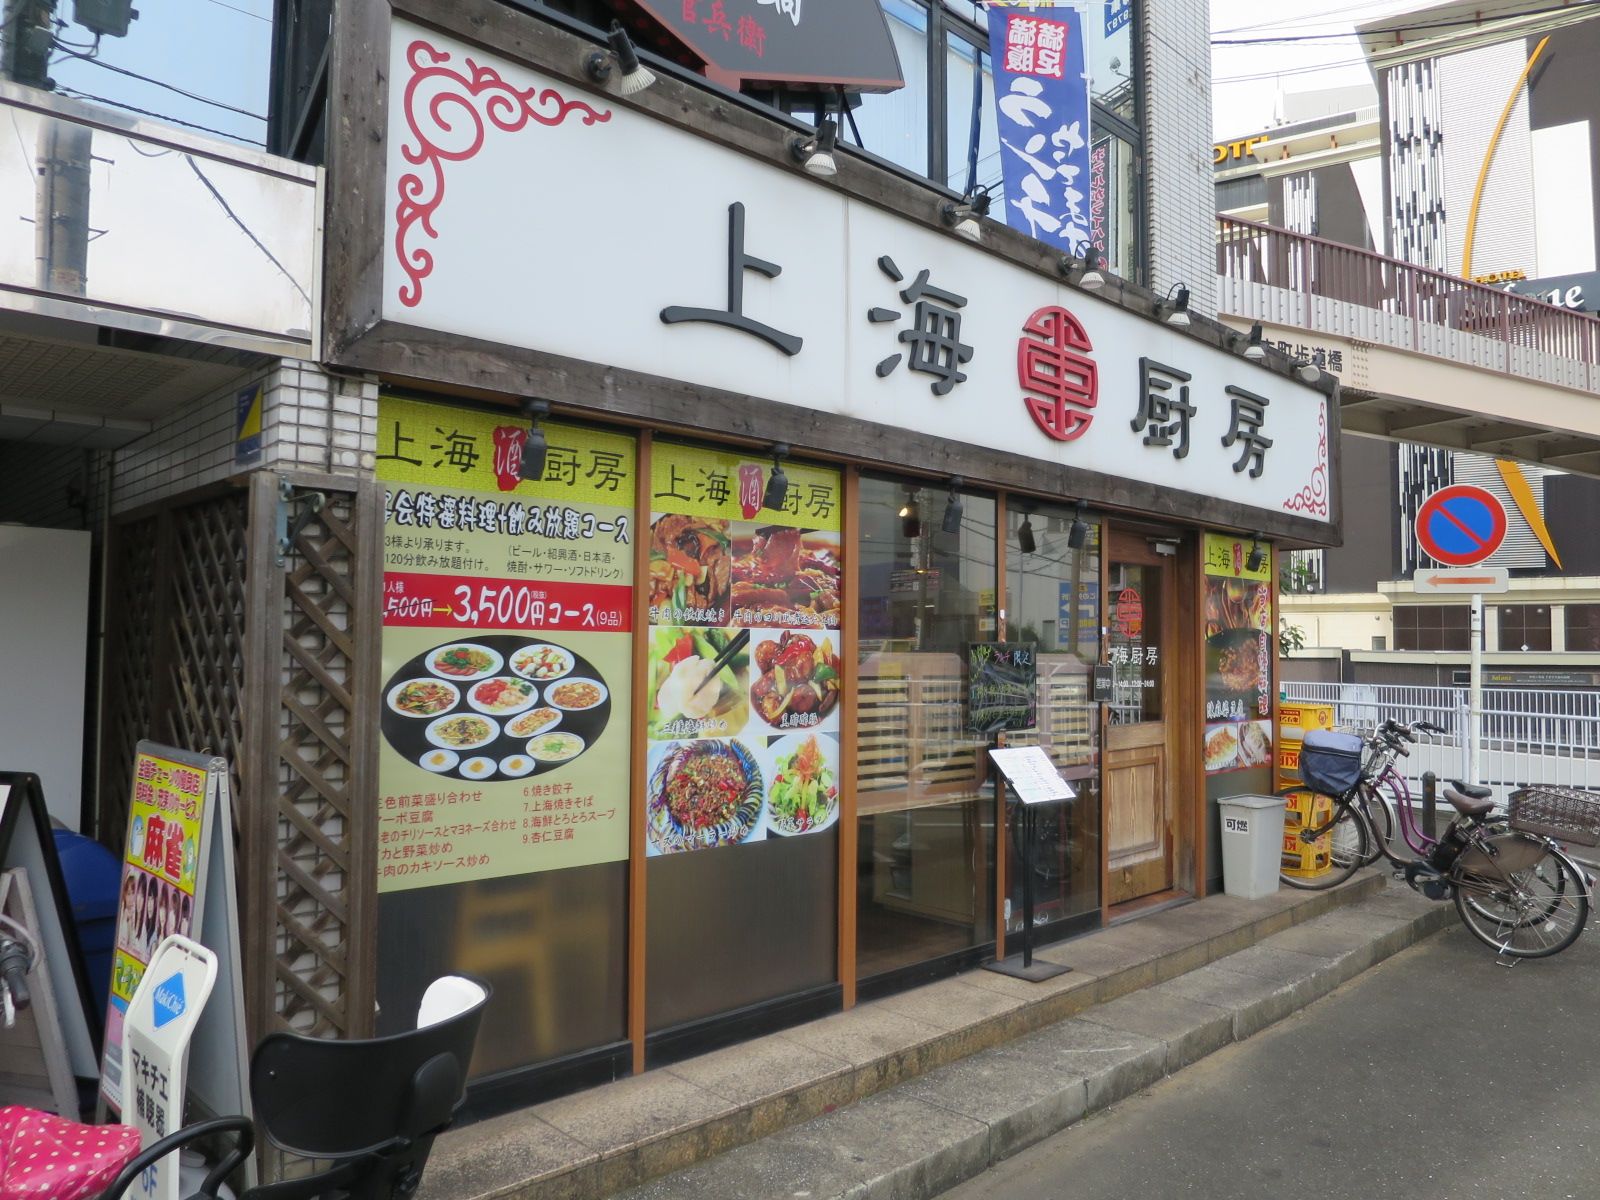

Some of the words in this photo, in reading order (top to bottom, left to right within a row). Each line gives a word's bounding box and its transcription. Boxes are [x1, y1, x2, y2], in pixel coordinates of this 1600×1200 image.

[659, 200, 975, 396] 上海
[1130, 356, 1274, 479] 厨房
[379, 818, 517, 844] 老のチリソースとマヨネーズ合わせ
